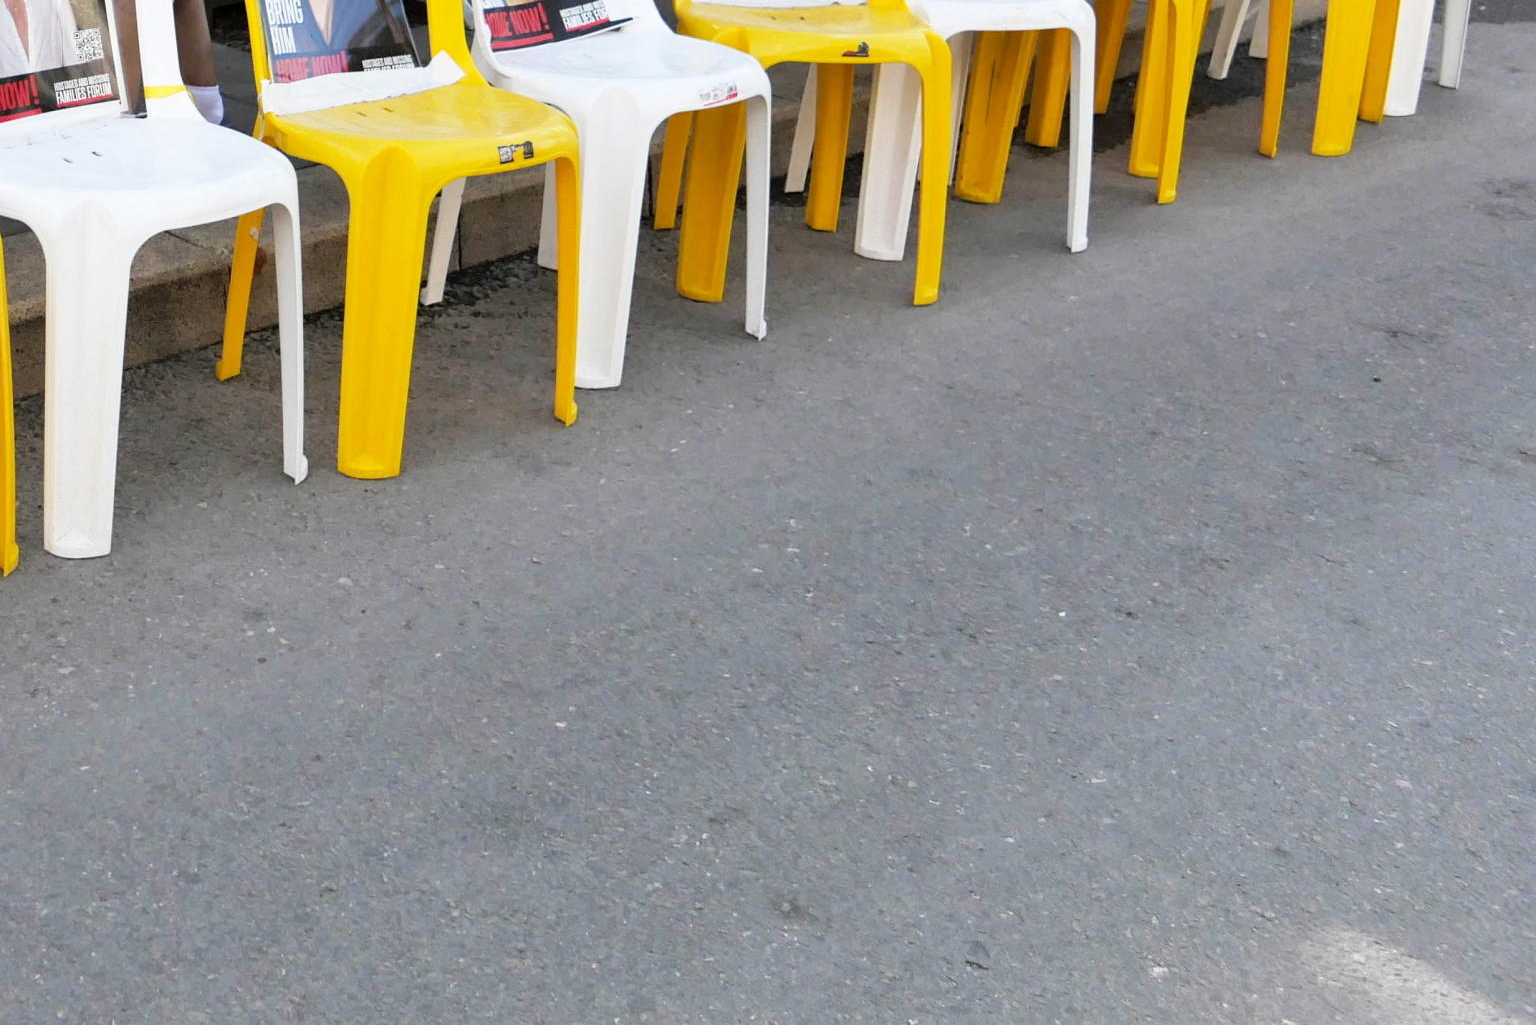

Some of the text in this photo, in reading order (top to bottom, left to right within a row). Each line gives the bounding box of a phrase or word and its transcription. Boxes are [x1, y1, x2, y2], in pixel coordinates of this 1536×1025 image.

[509, 2, 548, 35] NOW!
[270, 26, 296, 55] HIM
[55, 88, 86, 105] FAMILIES
[86, 82, 112, 98] FORUM
